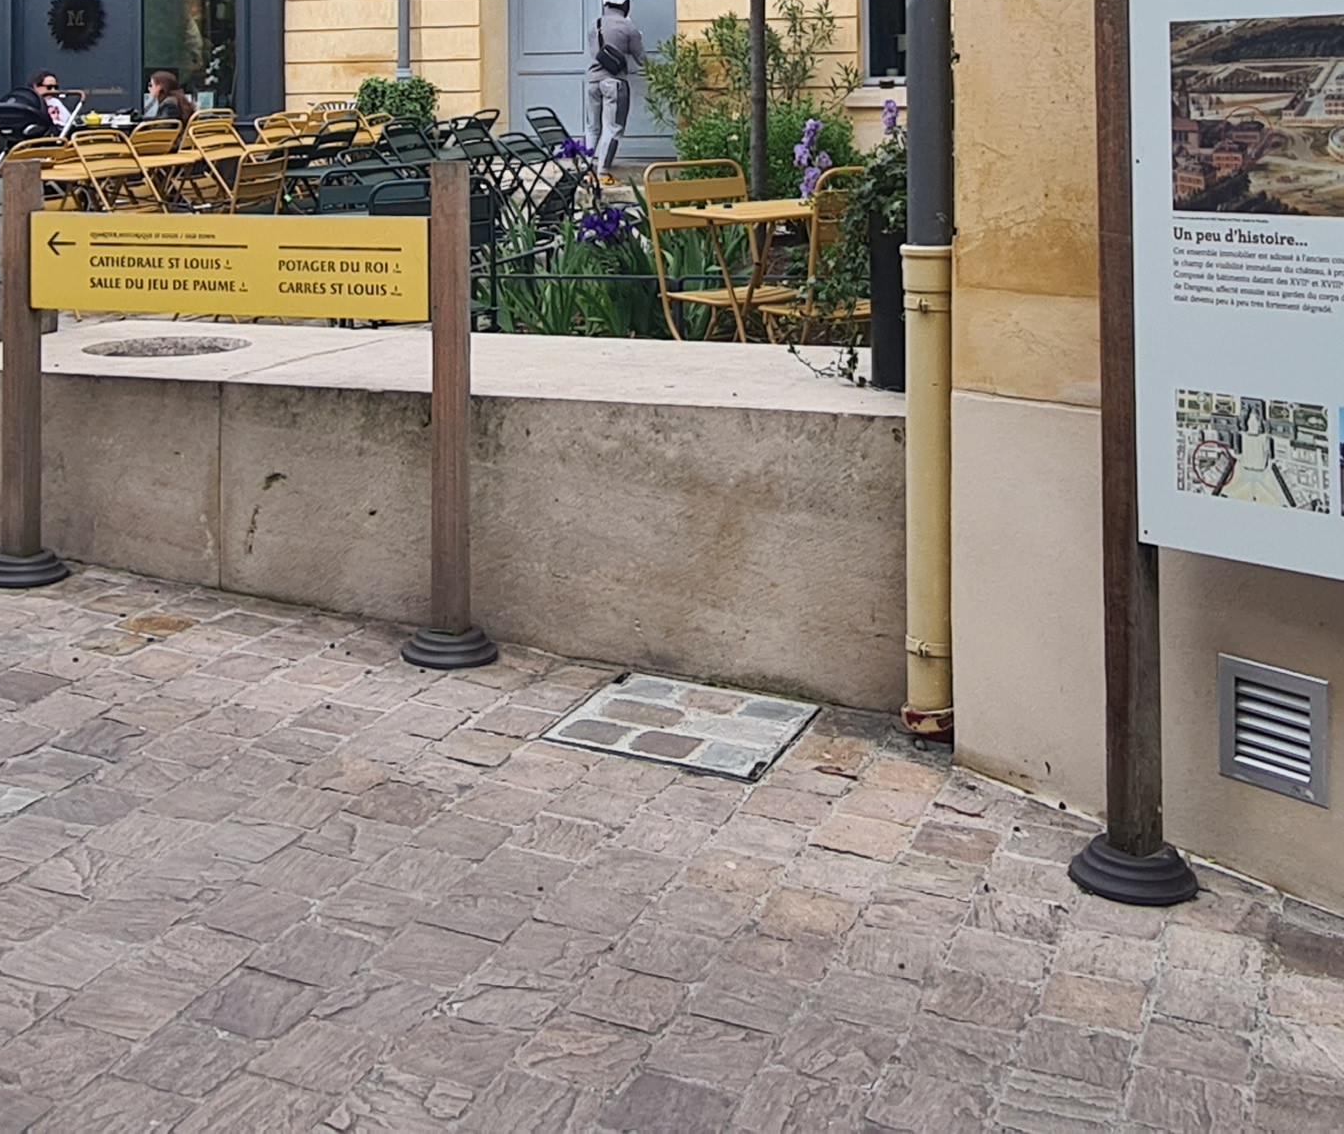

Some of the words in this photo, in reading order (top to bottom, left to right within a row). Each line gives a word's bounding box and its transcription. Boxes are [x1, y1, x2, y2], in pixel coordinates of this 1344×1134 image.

[66, 9, 86, 27] M
[1173, 227, 1192, 241] Un
[1196, 230, 1221, 246] peu
[1224, 229, 1308, 248] d'histoire...
[90, 255, 164, 268] CATHÉDRALE
[168, 257, 180, 269] ST
[184, 258, 221, 269] LOUIS
[278, 260, 336, 272] POTAGER
[340, 261, 360, 273] DU
[365, 262, 388, 273] ROI
[90, 277, 121, 288] SALLE
[125, 278, 144, 289] DU
[148, 279, 168, 291] JEU
[173, 279, 188, 290] DE
[193, 280, 236, 292] PAUME
[279, 281, 326, 294] CARRÉS
[330, 283, 344, 294] ST
[348, 284, 387, 296] LOUIS
